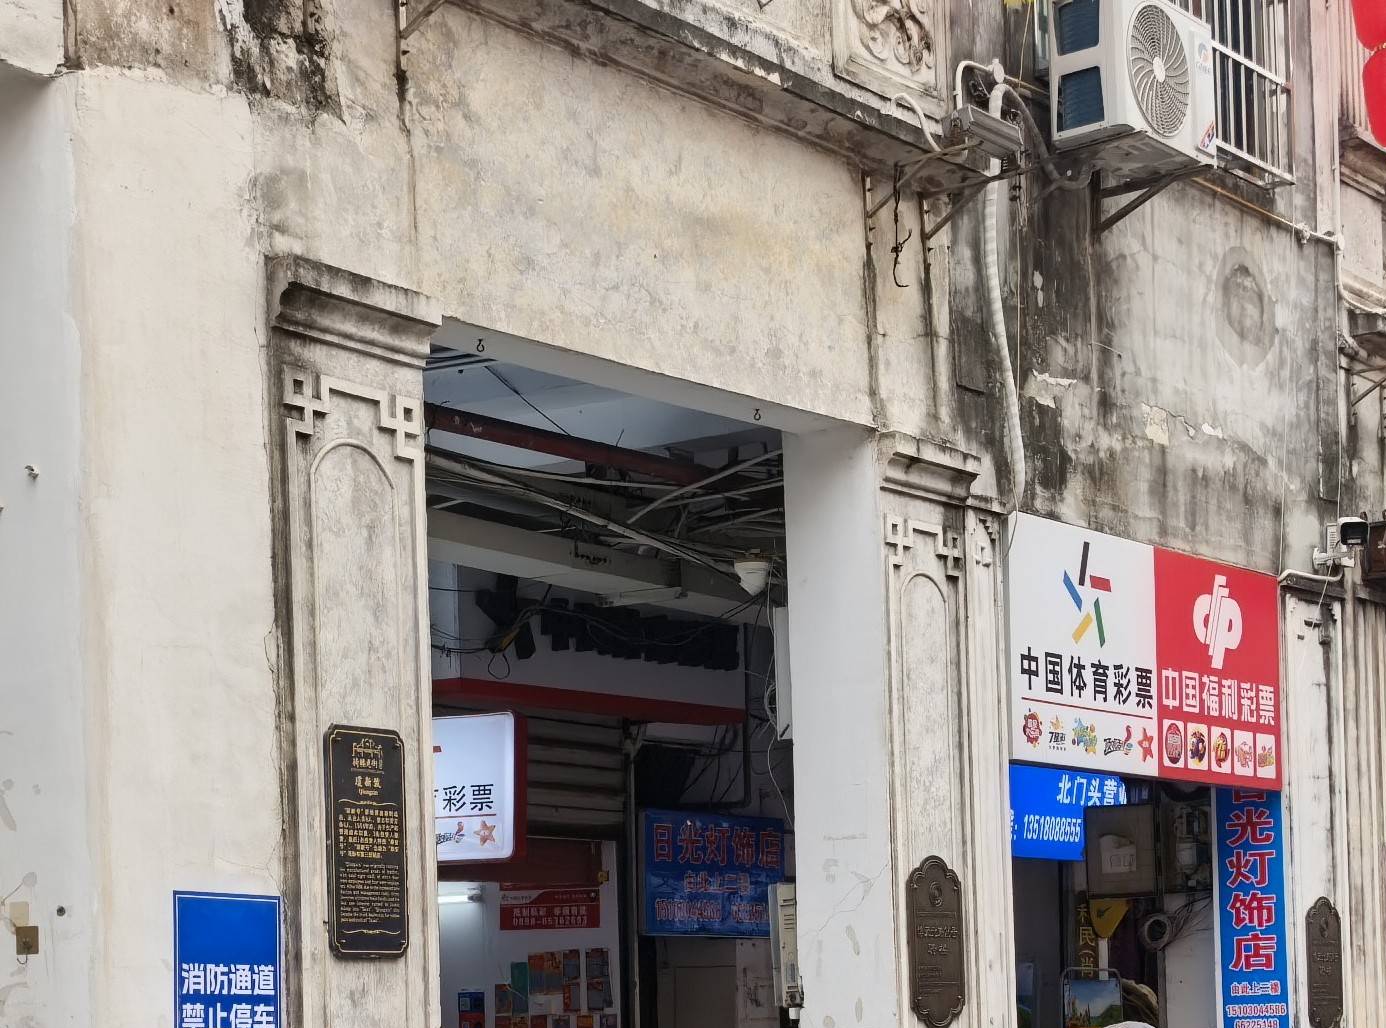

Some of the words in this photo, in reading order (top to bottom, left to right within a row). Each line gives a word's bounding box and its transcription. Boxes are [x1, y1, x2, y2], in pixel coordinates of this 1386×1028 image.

[1020, 646, 1153, 710] 中国体育彩票
[1161, 668, 1275, 725] 中国福利彩票
[434, 784, 494, 812] 彩票
[1023, 814, 1081, 842] 13518088555
[181, 963, 275, 996] 消防通道
